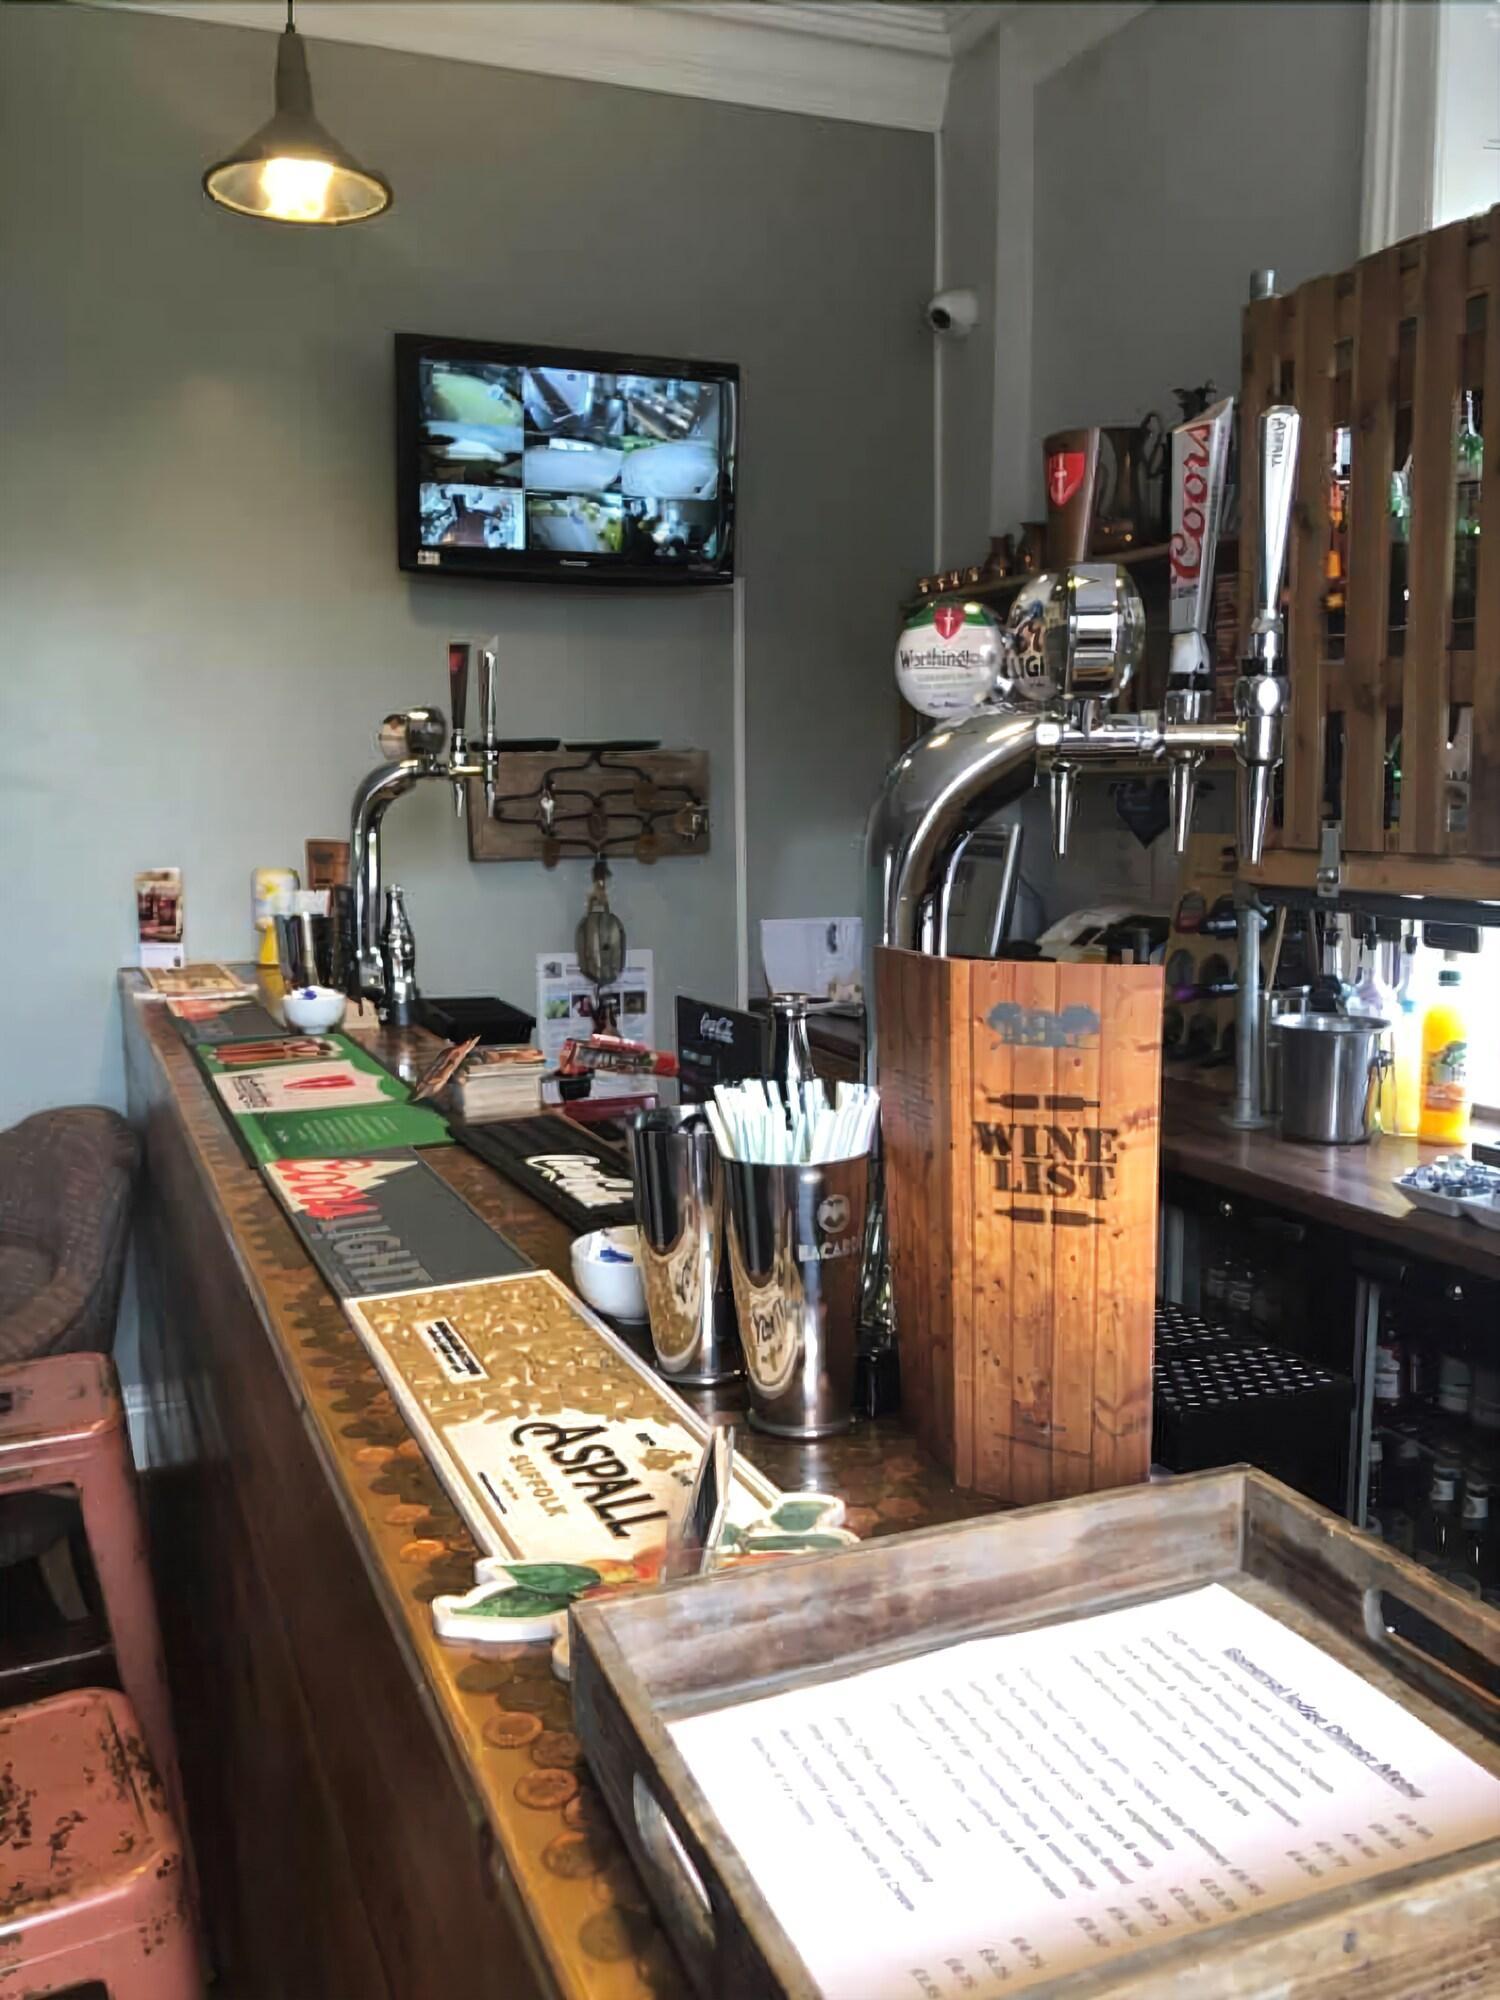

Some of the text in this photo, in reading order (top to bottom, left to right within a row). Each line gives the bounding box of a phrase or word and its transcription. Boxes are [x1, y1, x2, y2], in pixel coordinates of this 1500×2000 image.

[973, 1120, 1118, 1164] WINE
[993, 1159, 1116, 1200] LIST
[509, 1454, 568, 1517] SUFFOLK
[511, 1422, 670, 1539] ASPALL
